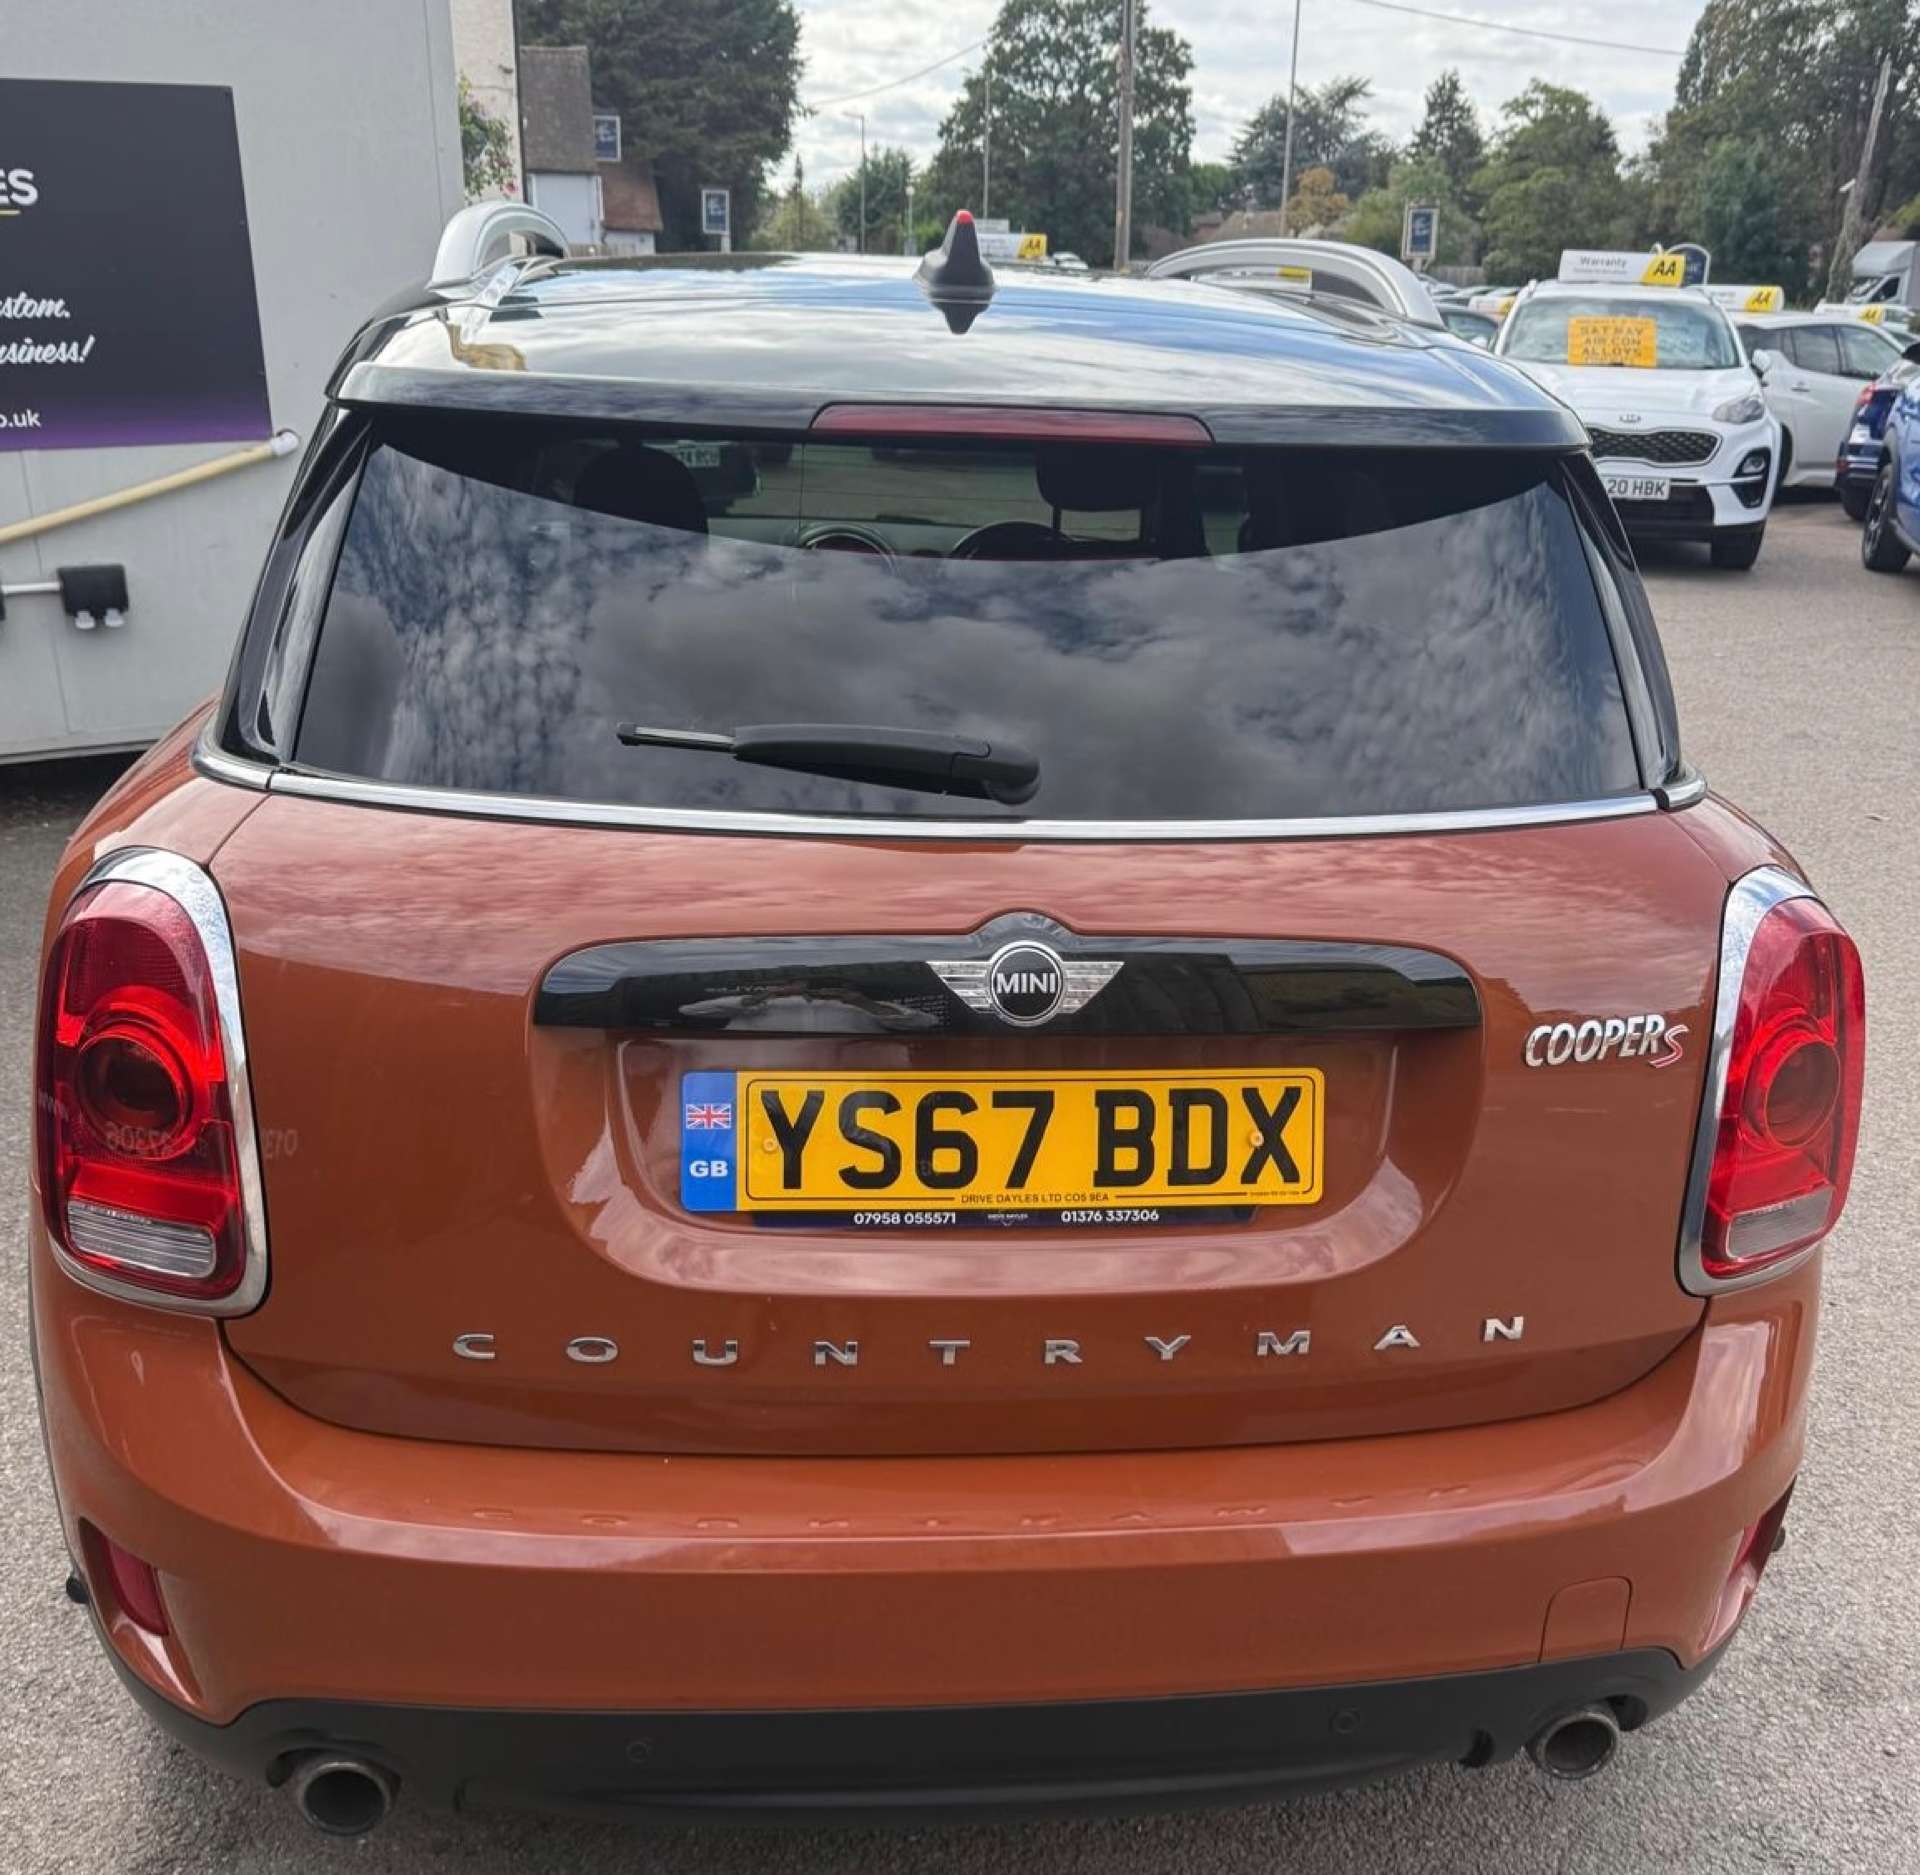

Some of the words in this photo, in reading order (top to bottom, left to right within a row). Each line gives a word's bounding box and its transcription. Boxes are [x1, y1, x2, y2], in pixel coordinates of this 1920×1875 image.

[1653, 260, 1677, 277] AA
[0, 291, 70, 318] stom.
[1631, 480, 1666, 495] HBK
[996, 972, 1056, 994] MINI
[761, 1089, 1055, 1190] YS67
[1093, 1087, 1302, 1188] BDX
[689, 1160, 728, 1177] GB
[961, 1194, 993, 1203] DRIVE
[996, 1193, 1039, 1203] DAYLES
[1042, 1193, 1062, 1203] LTD
[853, 1212, 900, 1225] 07958
[904, 1211, 957, 1225] 055571
[1060, 1210, 1102, 1223] 01376
[1106, 1209, 1159, 1222] 337306
[452, 1316, 1525, 1367] COUNTRYMAN
